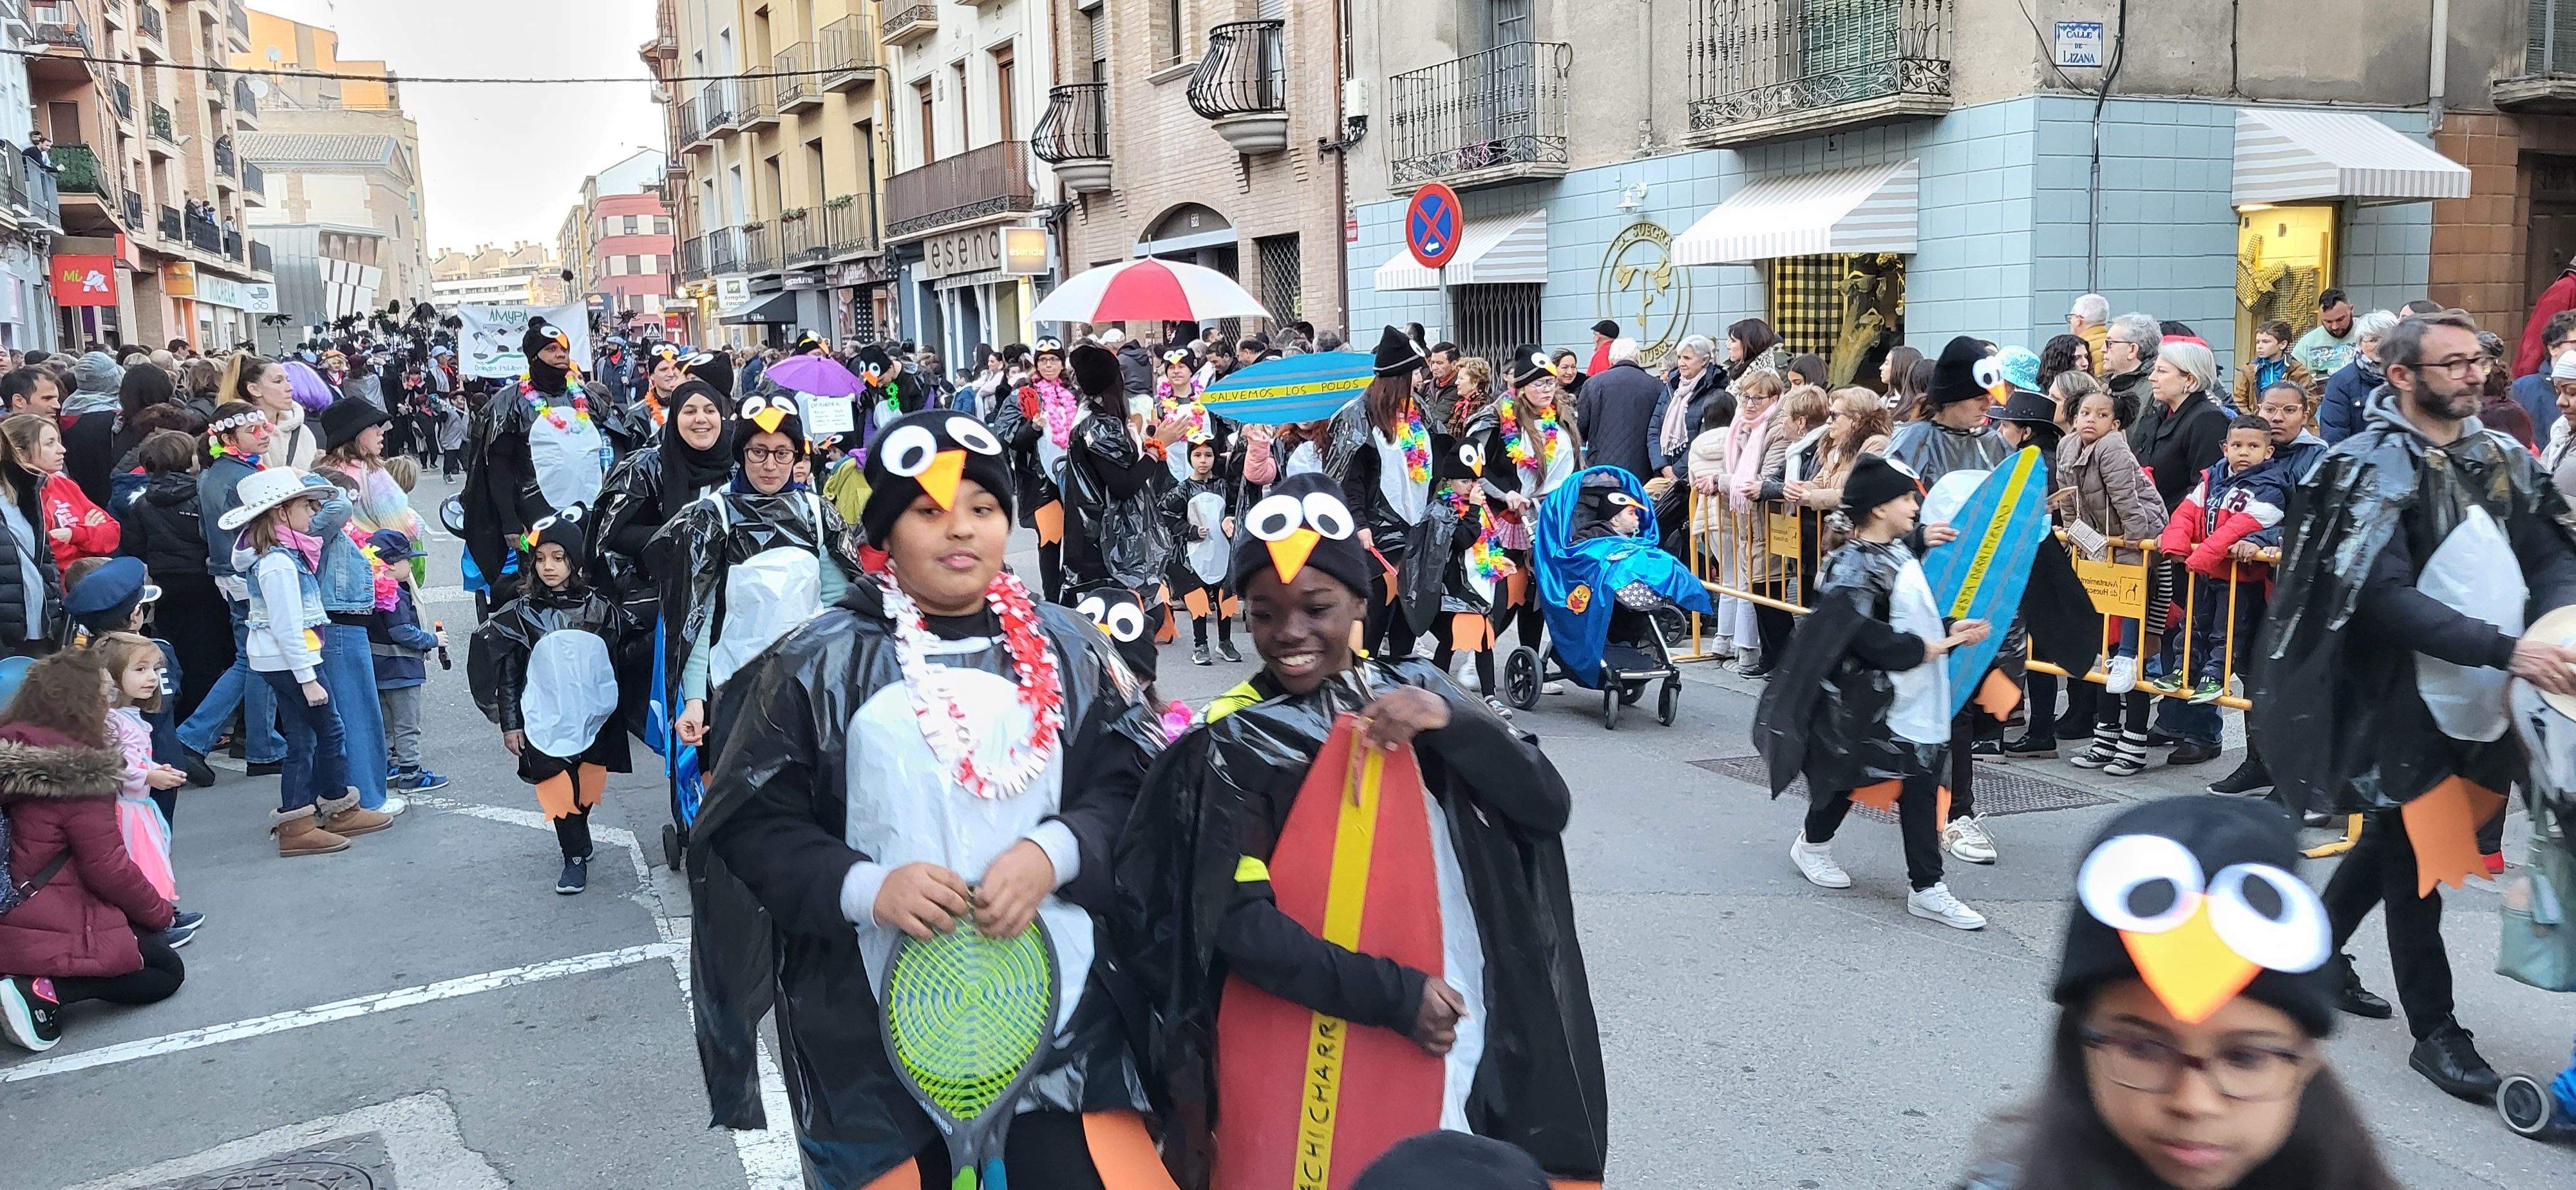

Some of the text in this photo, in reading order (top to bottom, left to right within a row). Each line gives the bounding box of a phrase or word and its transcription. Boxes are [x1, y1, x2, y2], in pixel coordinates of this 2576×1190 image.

[2066, 30, 2092, 39] CALLE
[1631, 224, 1672, 250] SUEGRA
[931, 231, 999, 269] esenc
[1009, 246, 1045, 256] esencia
[938, 276, 969, 288] esencia
[1210, 379, 1359, 402] SALVEMOS LOS POLOS
[1299, 1019, 1338, 1190] CHICHARR
